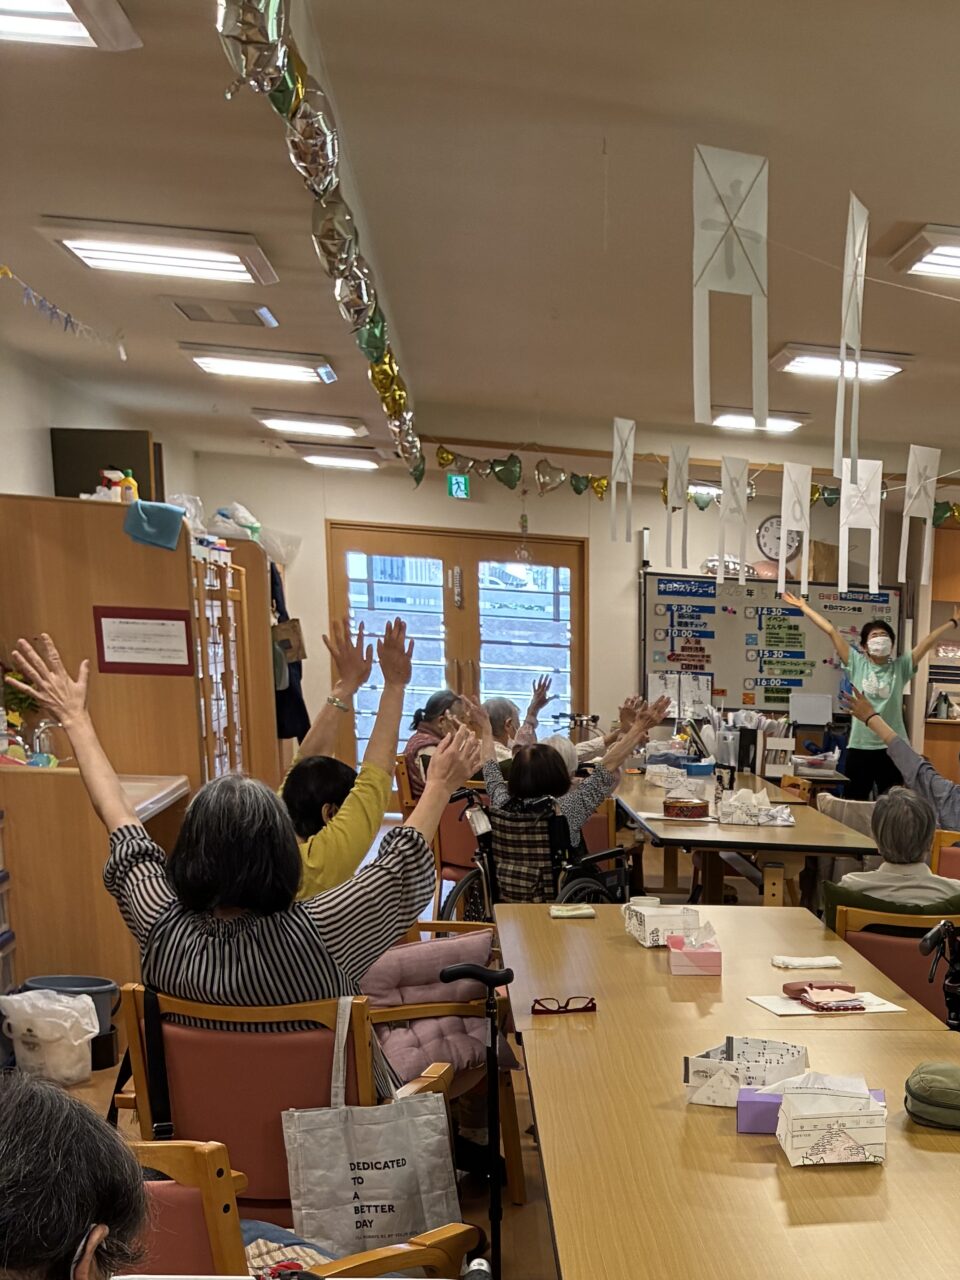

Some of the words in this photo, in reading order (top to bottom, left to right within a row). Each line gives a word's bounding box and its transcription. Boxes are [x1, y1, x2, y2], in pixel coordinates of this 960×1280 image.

[746, 588, 755, 598] 年
[350, 1158, 406, 1171] DEDICATED
[351, 1176, 364, 1186] TO
[353, 1191, 360, 1200] A
[354, 1204, 396, 1215] BETTER
[355, 1219, 374, 1230] DAY
